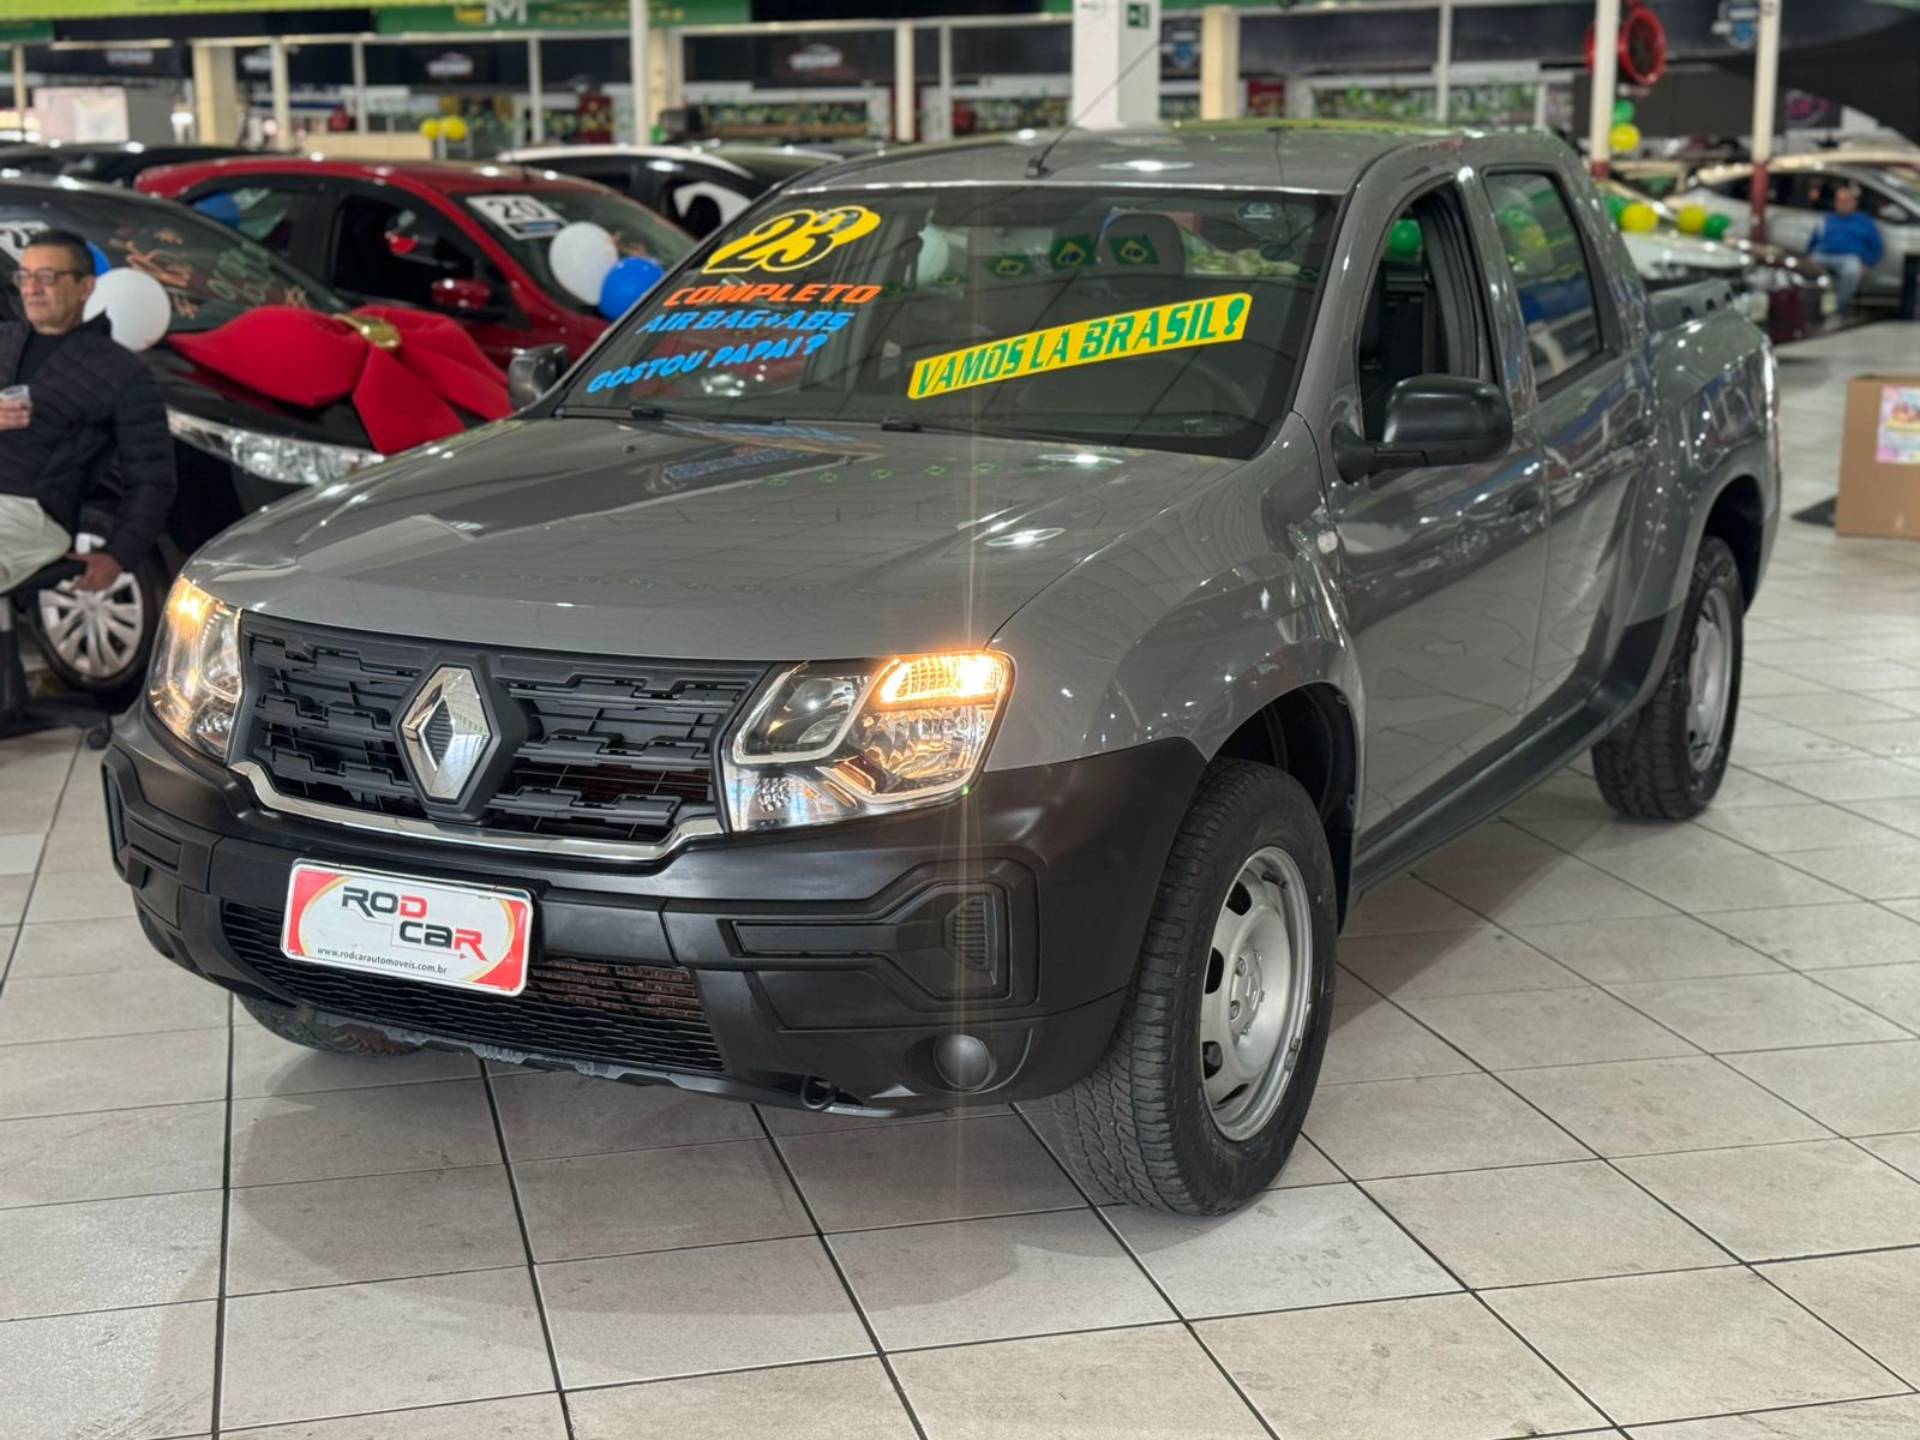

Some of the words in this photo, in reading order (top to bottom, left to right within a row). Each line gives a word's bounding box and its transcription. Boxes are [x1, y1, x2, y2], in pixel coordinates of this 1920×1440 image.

[486, 199, 546, 221] 20
[702, 205, 878, 274] 23
[662, 284, 882, 307] COMPLETO
[586, 351, 709, 394] GOSTOU
[917, 338, 1027, 396] VAMOS
[317, 947, 447, 975] www.rodcarautomoveis.com.br
